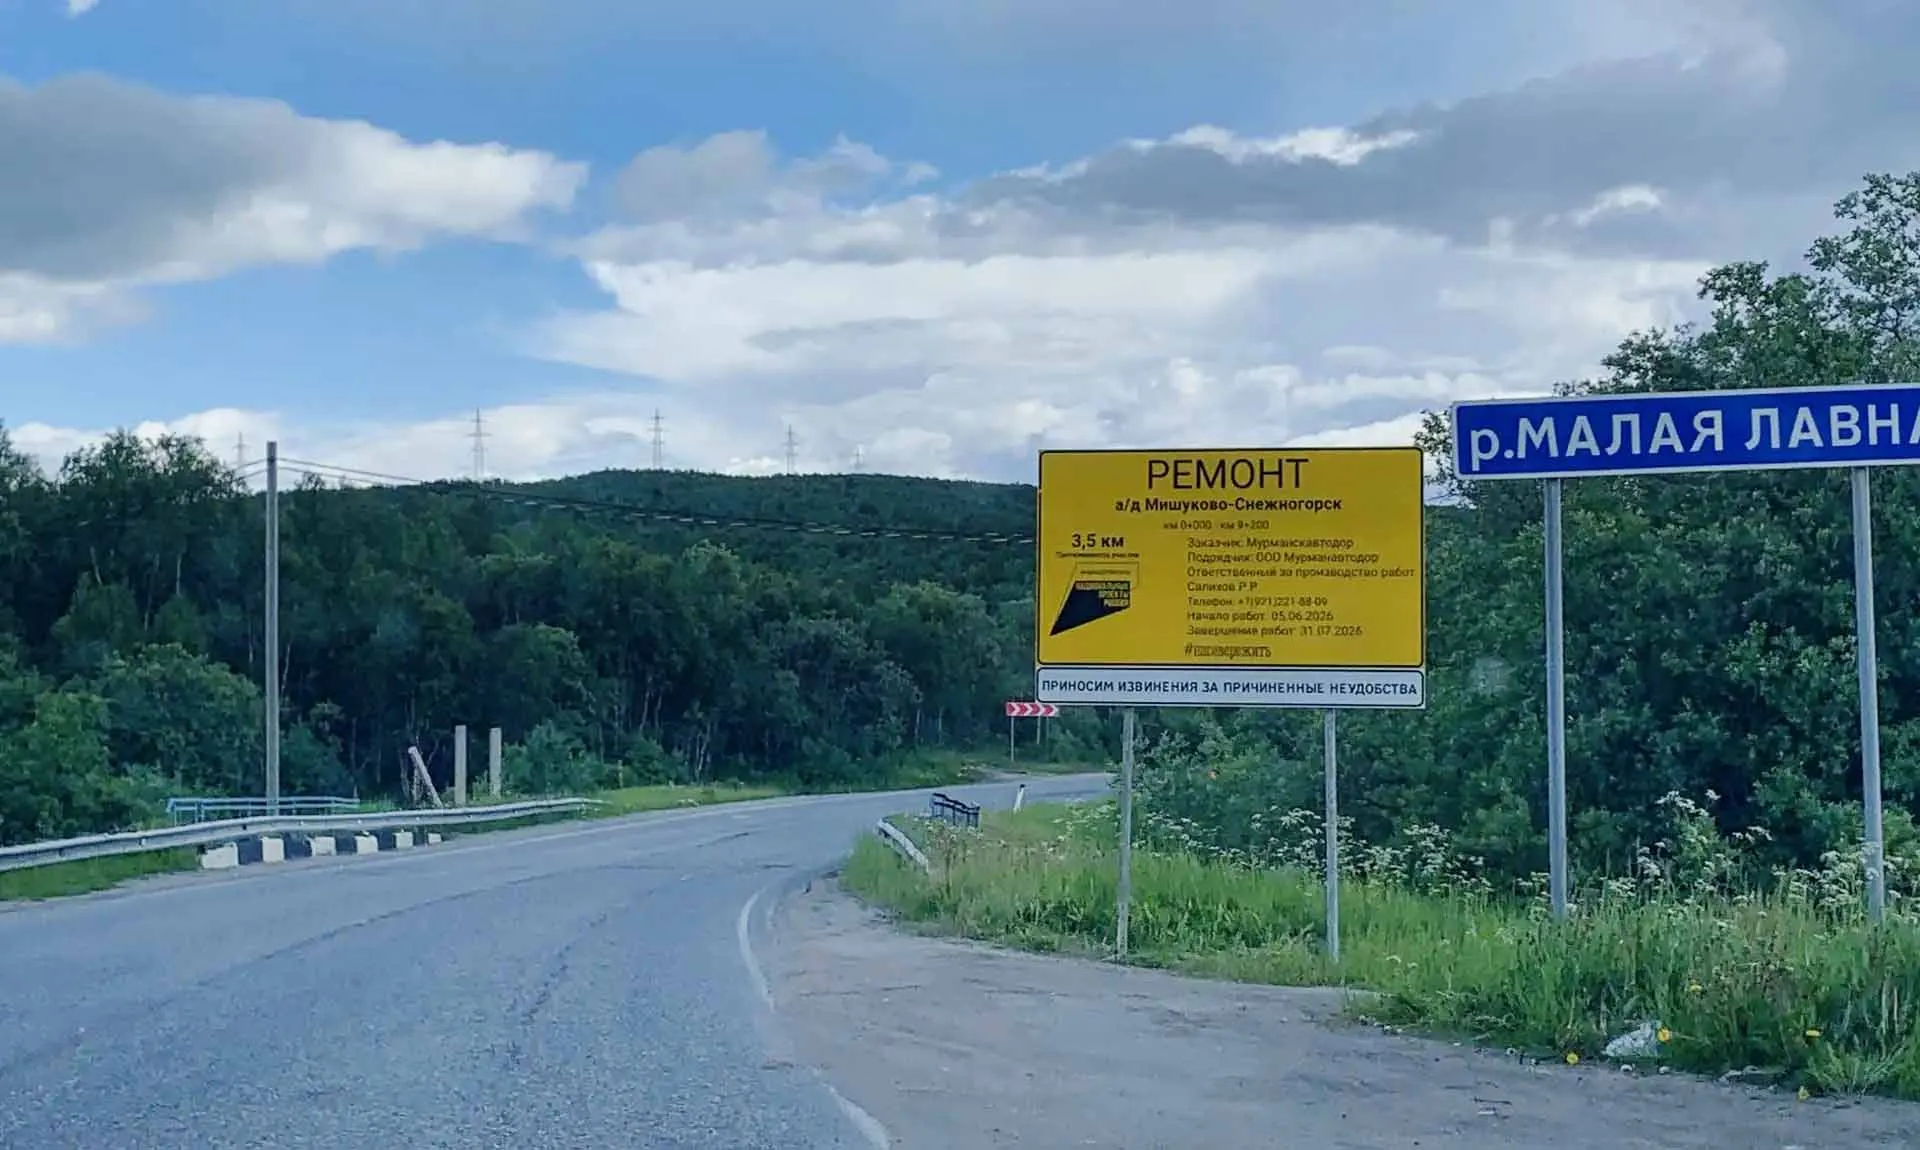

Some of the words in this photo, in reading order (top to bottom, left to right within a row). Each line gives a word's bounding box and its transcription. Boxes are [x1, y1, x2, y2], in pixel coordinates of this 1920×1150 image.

[1471, 410, 1723, 471] р.МАЛАЯ
[1745, 403, 1920, 451] ЛАВН
[1147, 459, 1309, 490] РЕМОНТ
[1115, 498, 1141, 513] а/д
[1145, 497, 1343, 514] Мишуково-Снежногорск
[1071, 533, 1097, 550] 3,5
[1101, 536, 1125, 548] км
[1246, 537, 1354, 550] Мурманскавтодор
[1256, 551, 1281, 562] ООО
[1186, 566, 1277, 578] Ответственный
[1279, 569, 1294, 577] за
[1295, 567, 1378, 579] производство
[1381, 566, 1415, 579] работ
[1187, 611, 1229, 622] Начало
[1042, 679, 1115, 693] ПРИНОСИМ
[1118, 680, 1198, 694] ИЗВИНЕНИЯ
[1202, 681, 1218, 693] ЗА
[1223, 681, 1324, 695] ПРИЧИНЕННЫЕ
[1329, 683, 1417, 696] НЕУДОБСТВА
